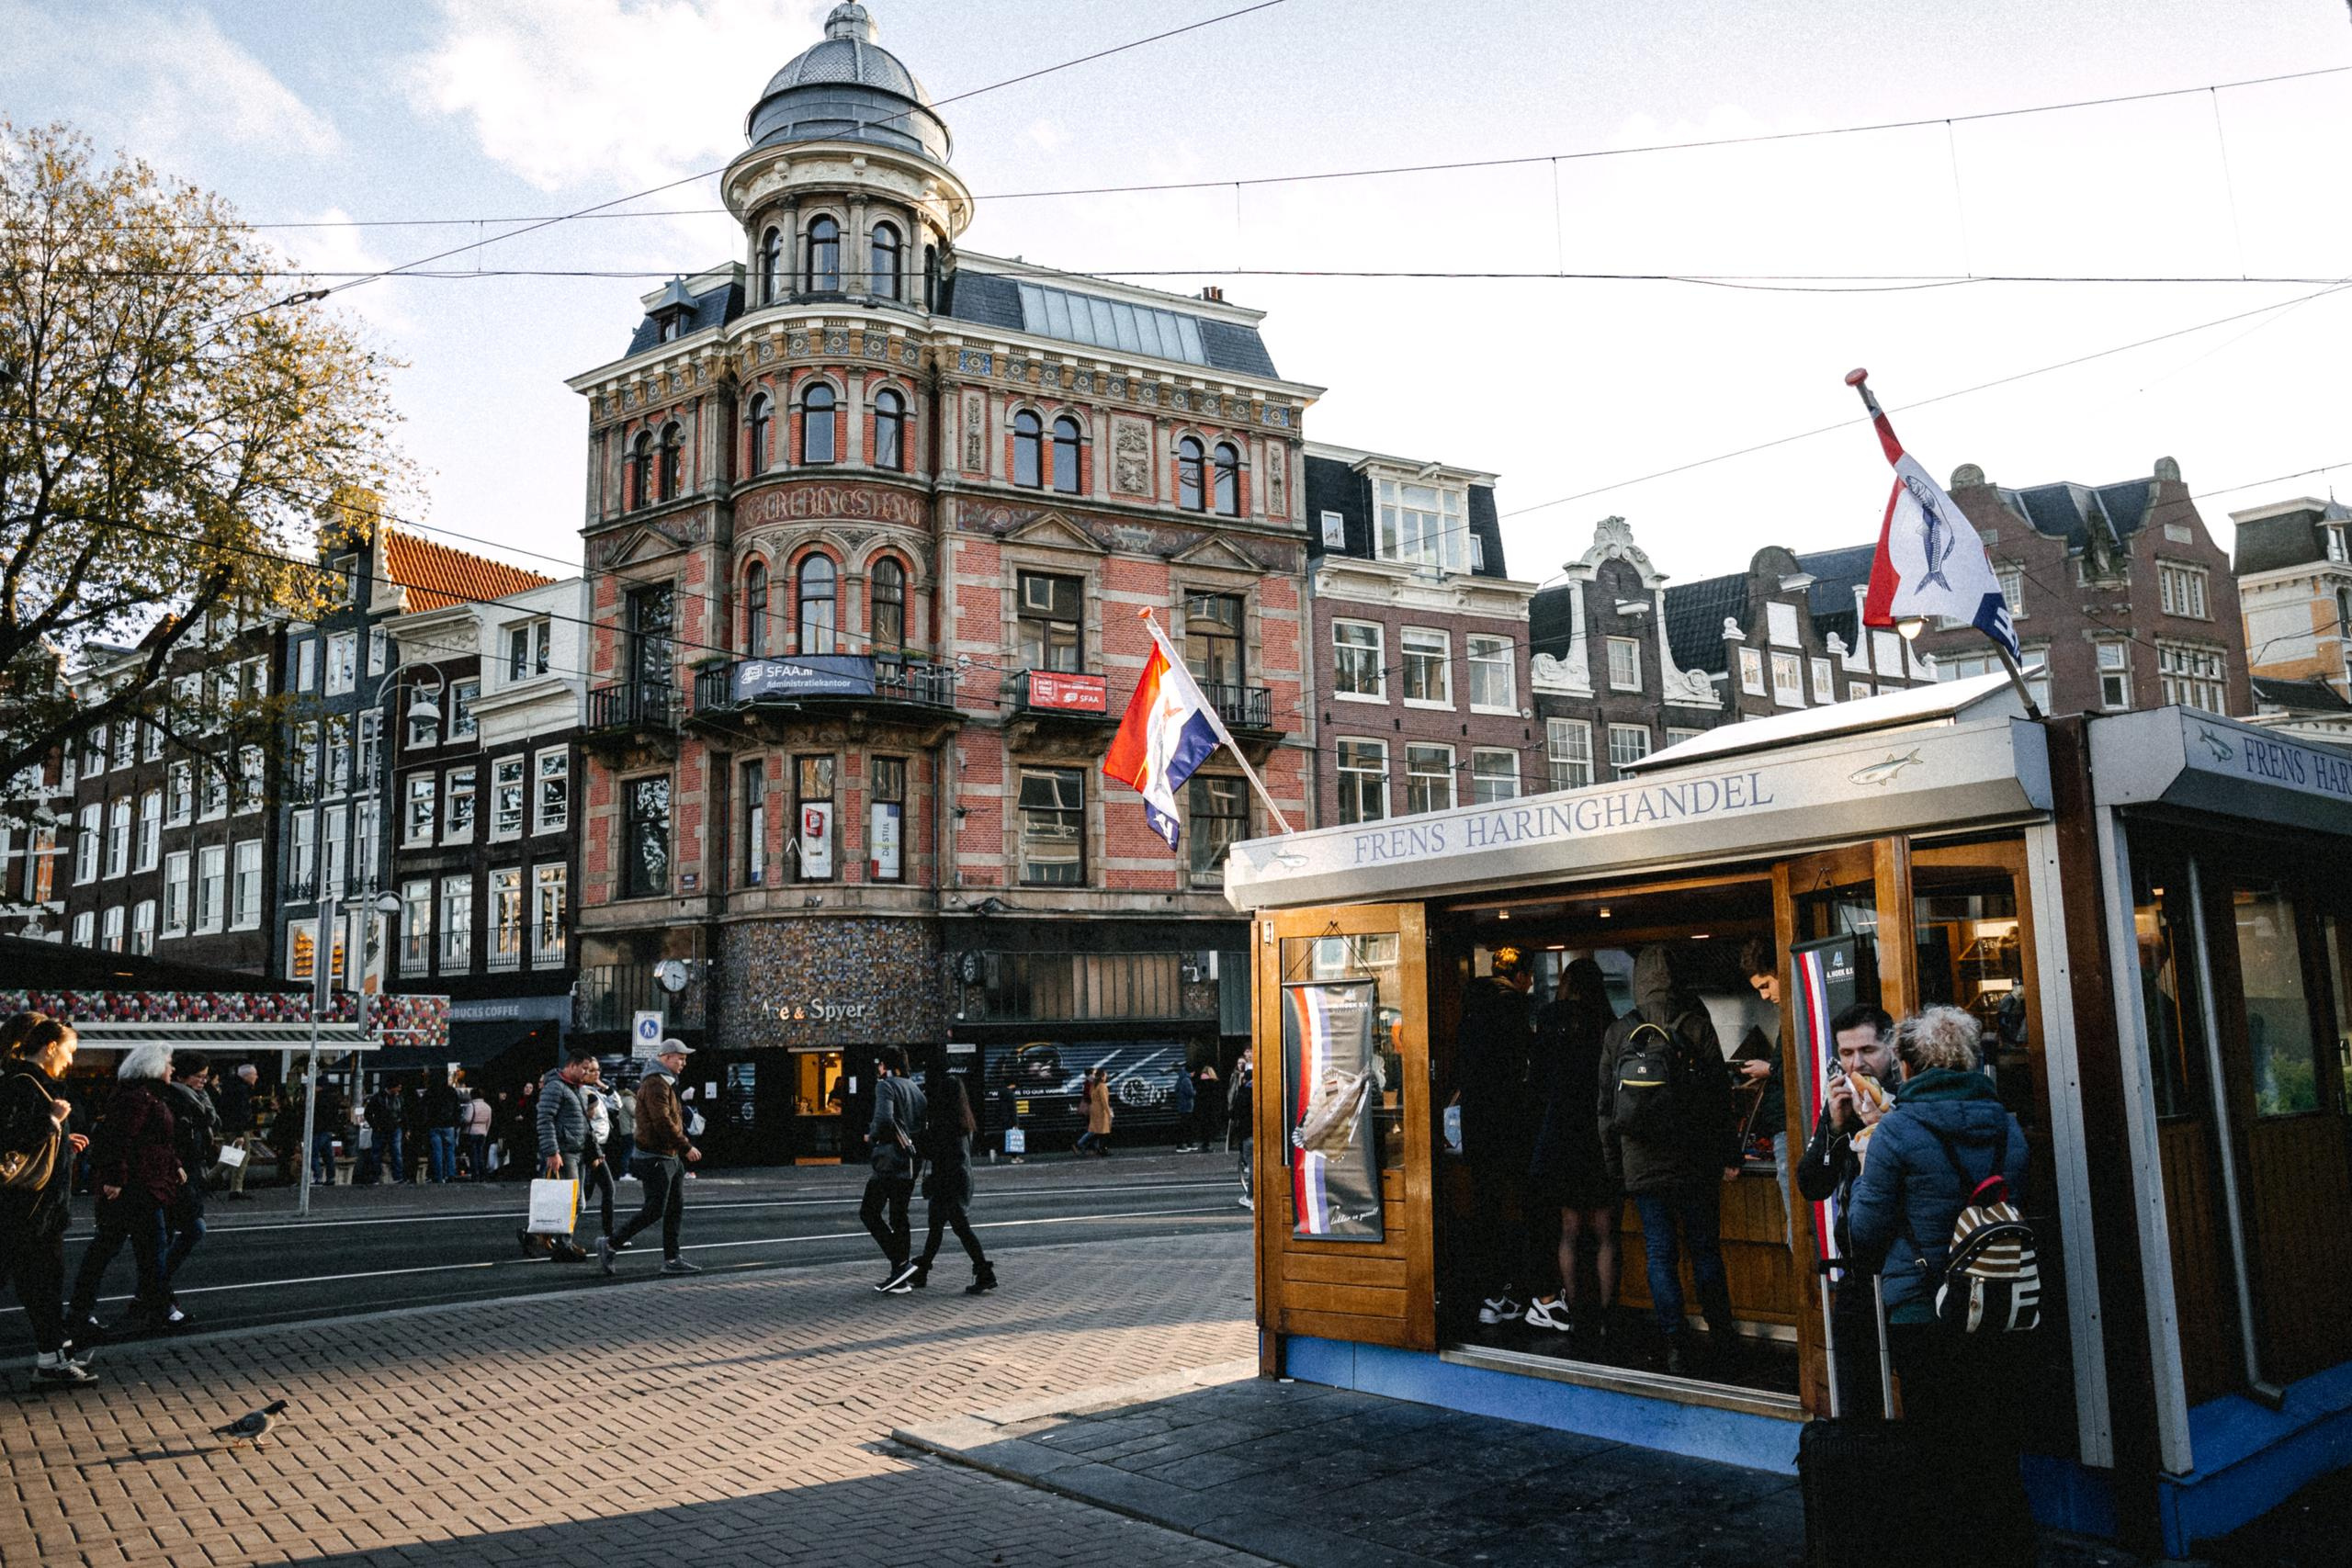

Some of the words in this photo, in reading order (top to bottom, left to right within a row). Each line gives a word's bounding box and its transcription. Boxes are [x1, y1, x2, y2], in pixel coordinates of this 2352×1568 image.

[766, 679, 851, 689] Administratiekantoor
[1080, 694, 1099, 703] SFAA
[2243, 737, 2305, 784] FRENS
[2312, 755, 2352, 795] HAR
[1353, 823, 1445, 864] FRENS
[1464, 771, 1774, 849] HARINGHANDEL
[449, 1006, 484, 1018] RBUCKS
[485, 1005, 519, 1017] COFFEE
[758, 999, 789, 1021] Ace
[794, 1006, 805, 1020] &
[809, 998, 865, 1021] Spyer
